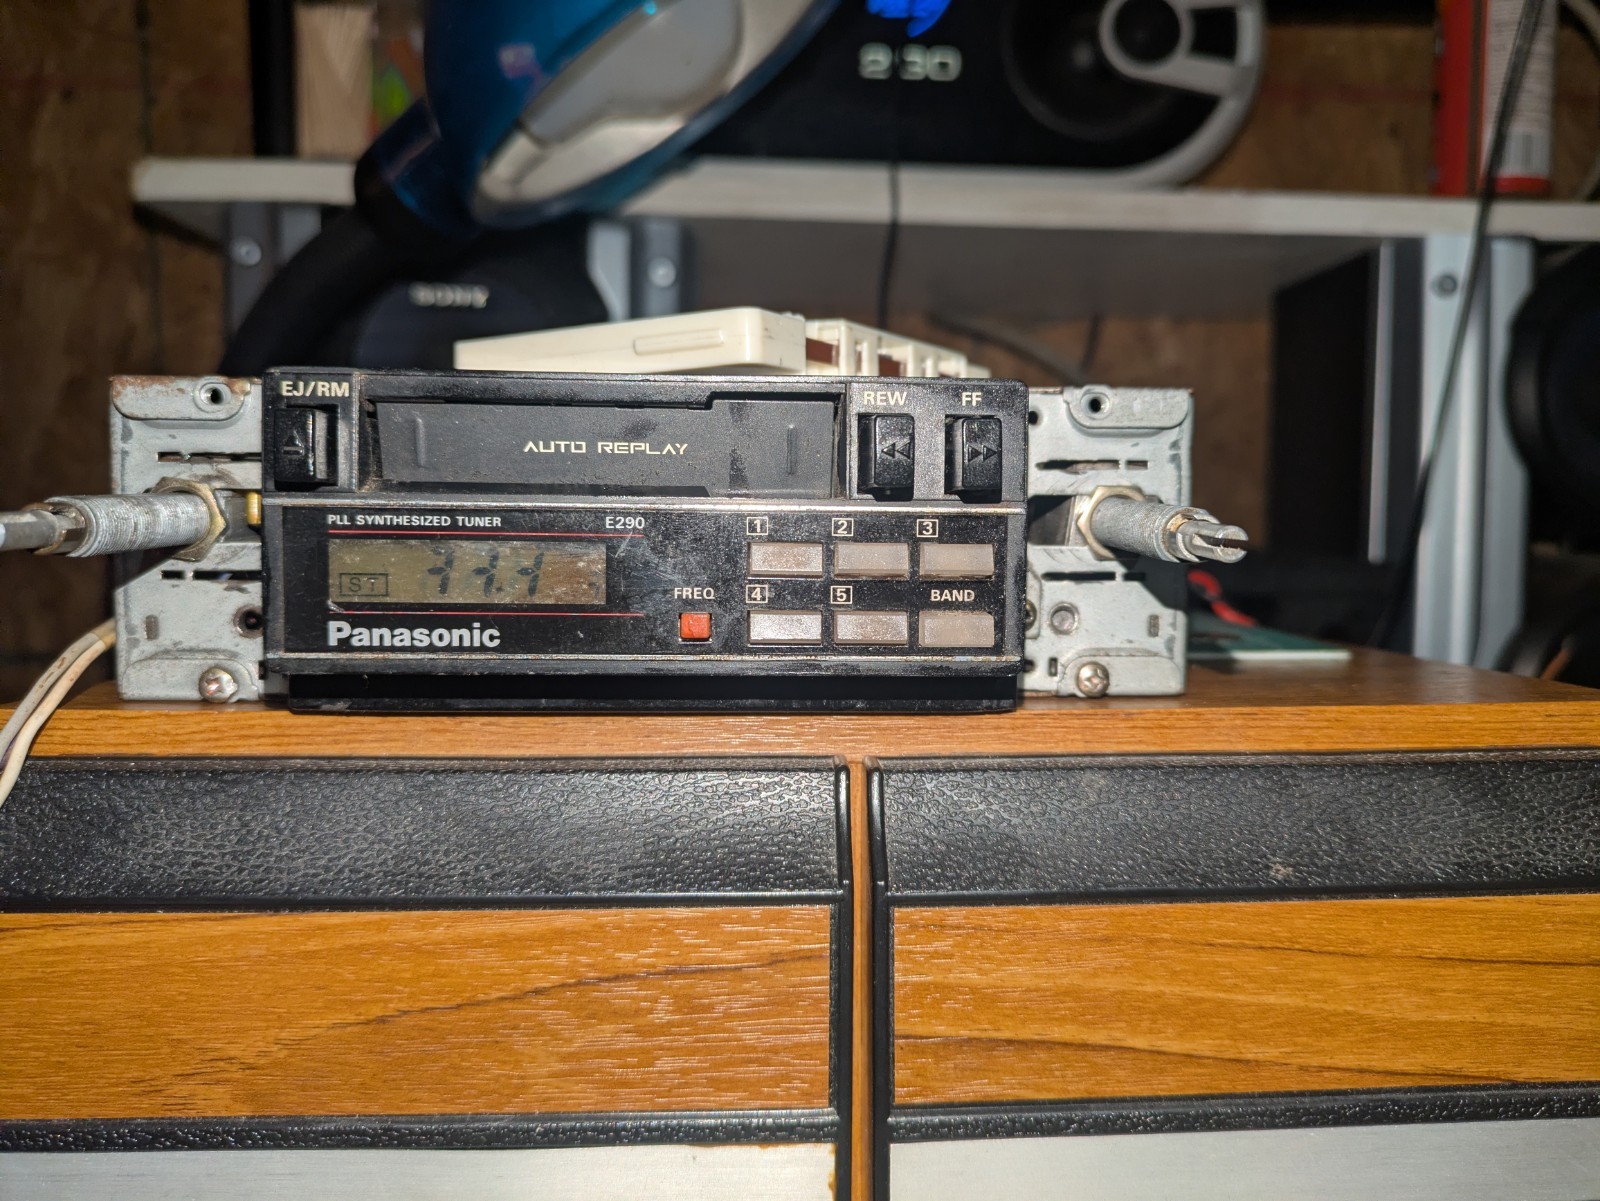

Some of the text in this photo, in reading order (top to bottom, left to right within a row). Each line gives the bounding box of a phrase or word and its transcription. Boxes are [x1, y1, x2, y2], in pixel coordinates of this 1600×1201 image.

[281, 380, 350, 398] EJ/RM
[863, 391, 907, 406] REW
[961, 391, 982, 406] FF
[523, 440, 688, 455] AUTO REPLAY
[327, 514, 502, 527] PLL SYNTHESIZED TUNER
[605, 516, 645, 530] E290
[674, 586, 715, 600] FREQ
[930, 589, 976, 602] BAND
[327, 620, 501, 648] Panasonic
